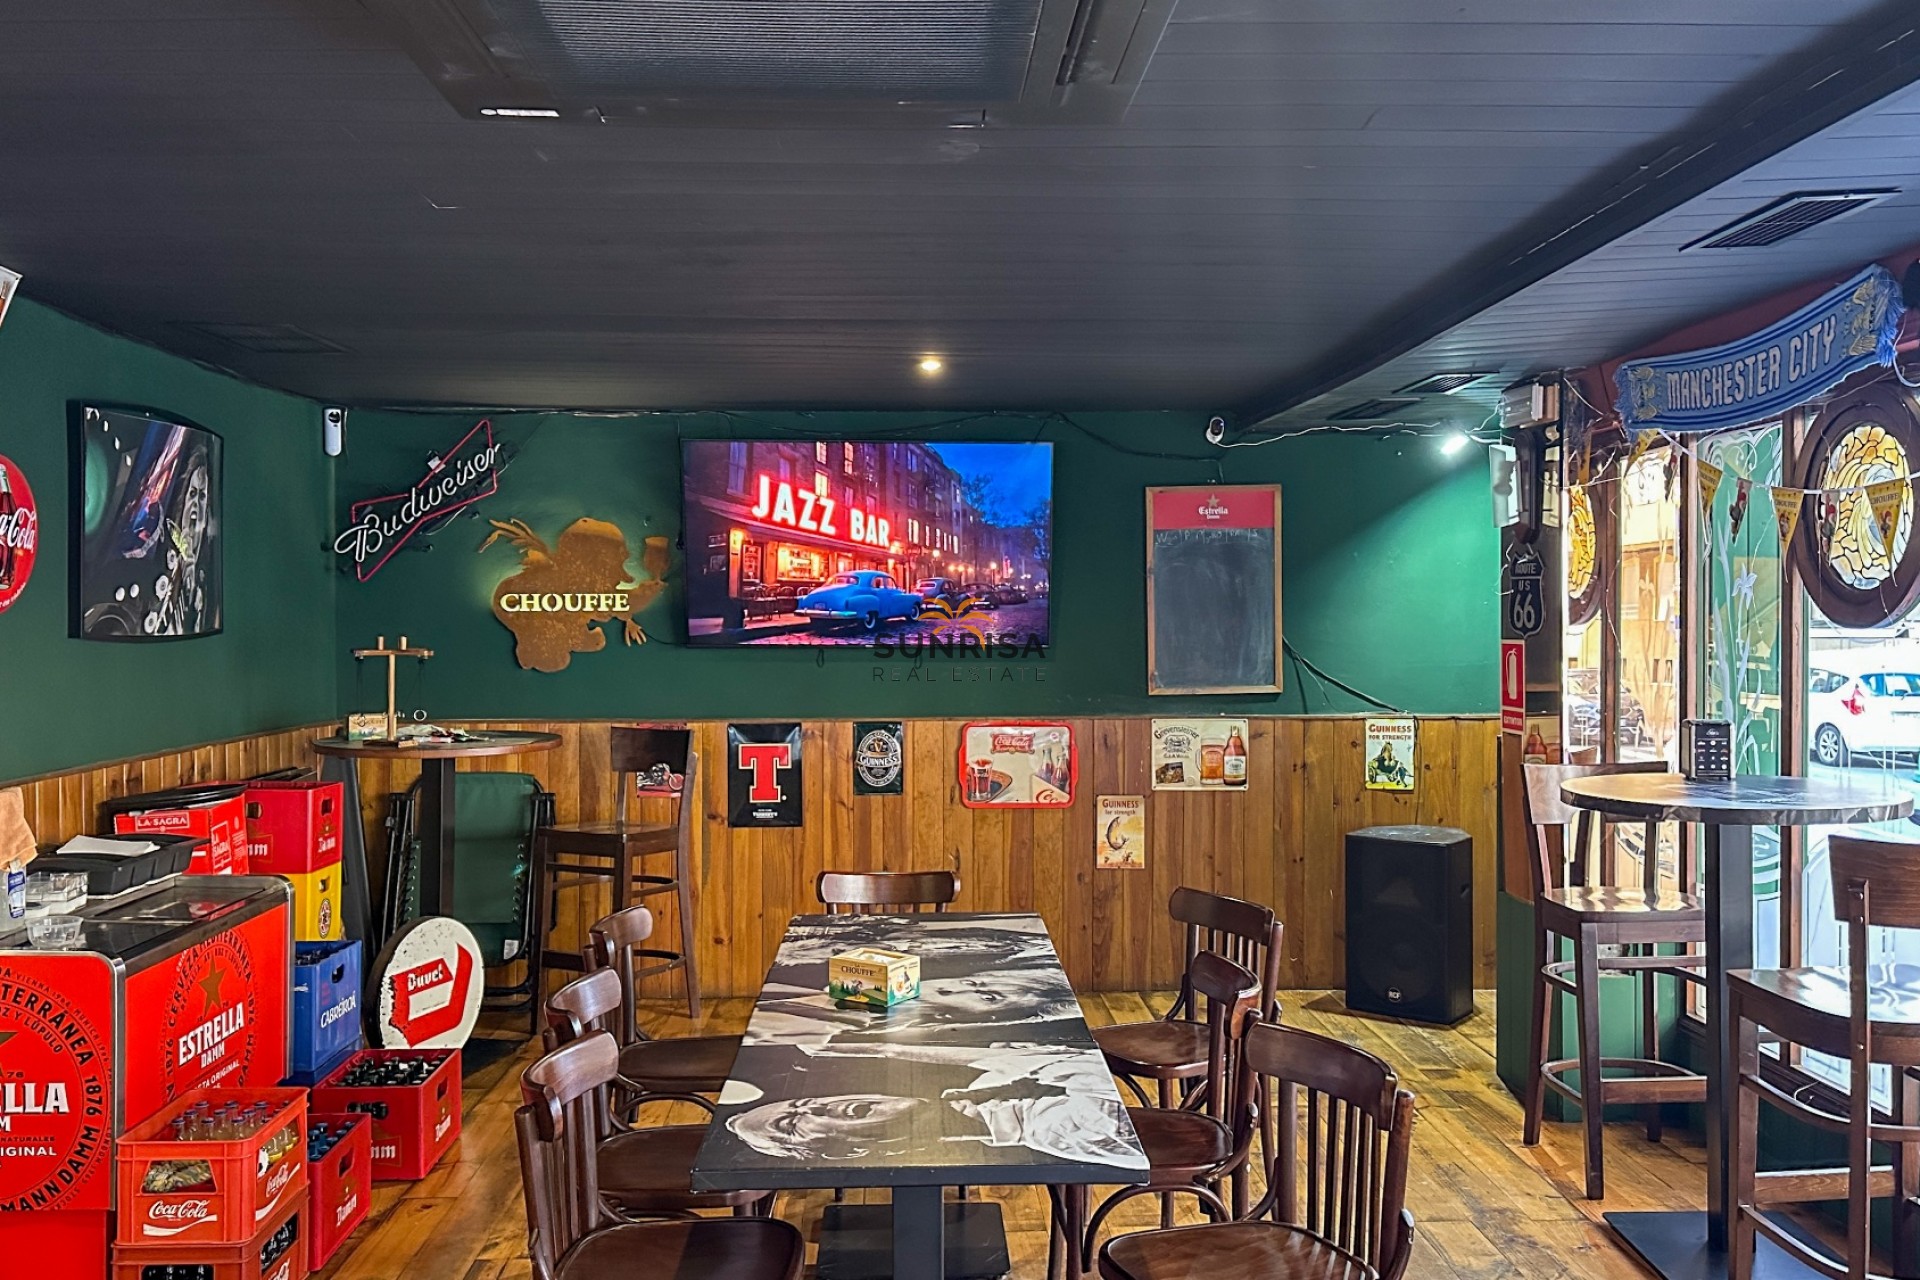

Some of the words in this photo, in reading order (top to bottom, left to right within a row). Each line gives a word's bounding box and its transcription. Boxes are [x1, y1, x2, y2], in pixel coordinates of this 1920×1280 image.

[1666, 346, 1781, 411] MANCHESTER
[1788, 315, 1837, 383] CITY
[334, 443, 500, 562] Budweiser
[752, 474, 836, 535] JAZZ
[850, 507, 890, 548] BAR
[1198, 506, 1229, 515] Estrella
[1514, 562, 1537, 575] ROUTE
[1518, 580, 1530, 591] US
[500, 593, 630, 612] CHOUFFE
[1513, 594, 1535, 628] 66
[1368, 724, 1412, 732] GUINNESS
[860, 752, 899, 767] GUINNESS
[1102, 799, 1139, 808] GUINNESS
[137, 819, 150, 828] LA
[153, 816, 187, 826] SAGRA
[16, 973, 50, 993] VIENNA
[407, 963, 444, 992] Duvel
[23, 1016, 64, 1053] LÚPULO
[178, 1002, 244, 1067] ESTRELLA
[200, 1041, 225, 1069] DAMM
[7, 1071, 24, 1079] 76
[210, 1060, 240, 1083] ORIGINAL
[0, 1082, 70, 1114] LLA
[85, 1075, 103, 1116] 1876
[57, 1125, 101, 1185] DAMM
[265, 1161, 290, 1198] Coca-Cola
[148, 1200, 211, 1220] Coca-Cola
